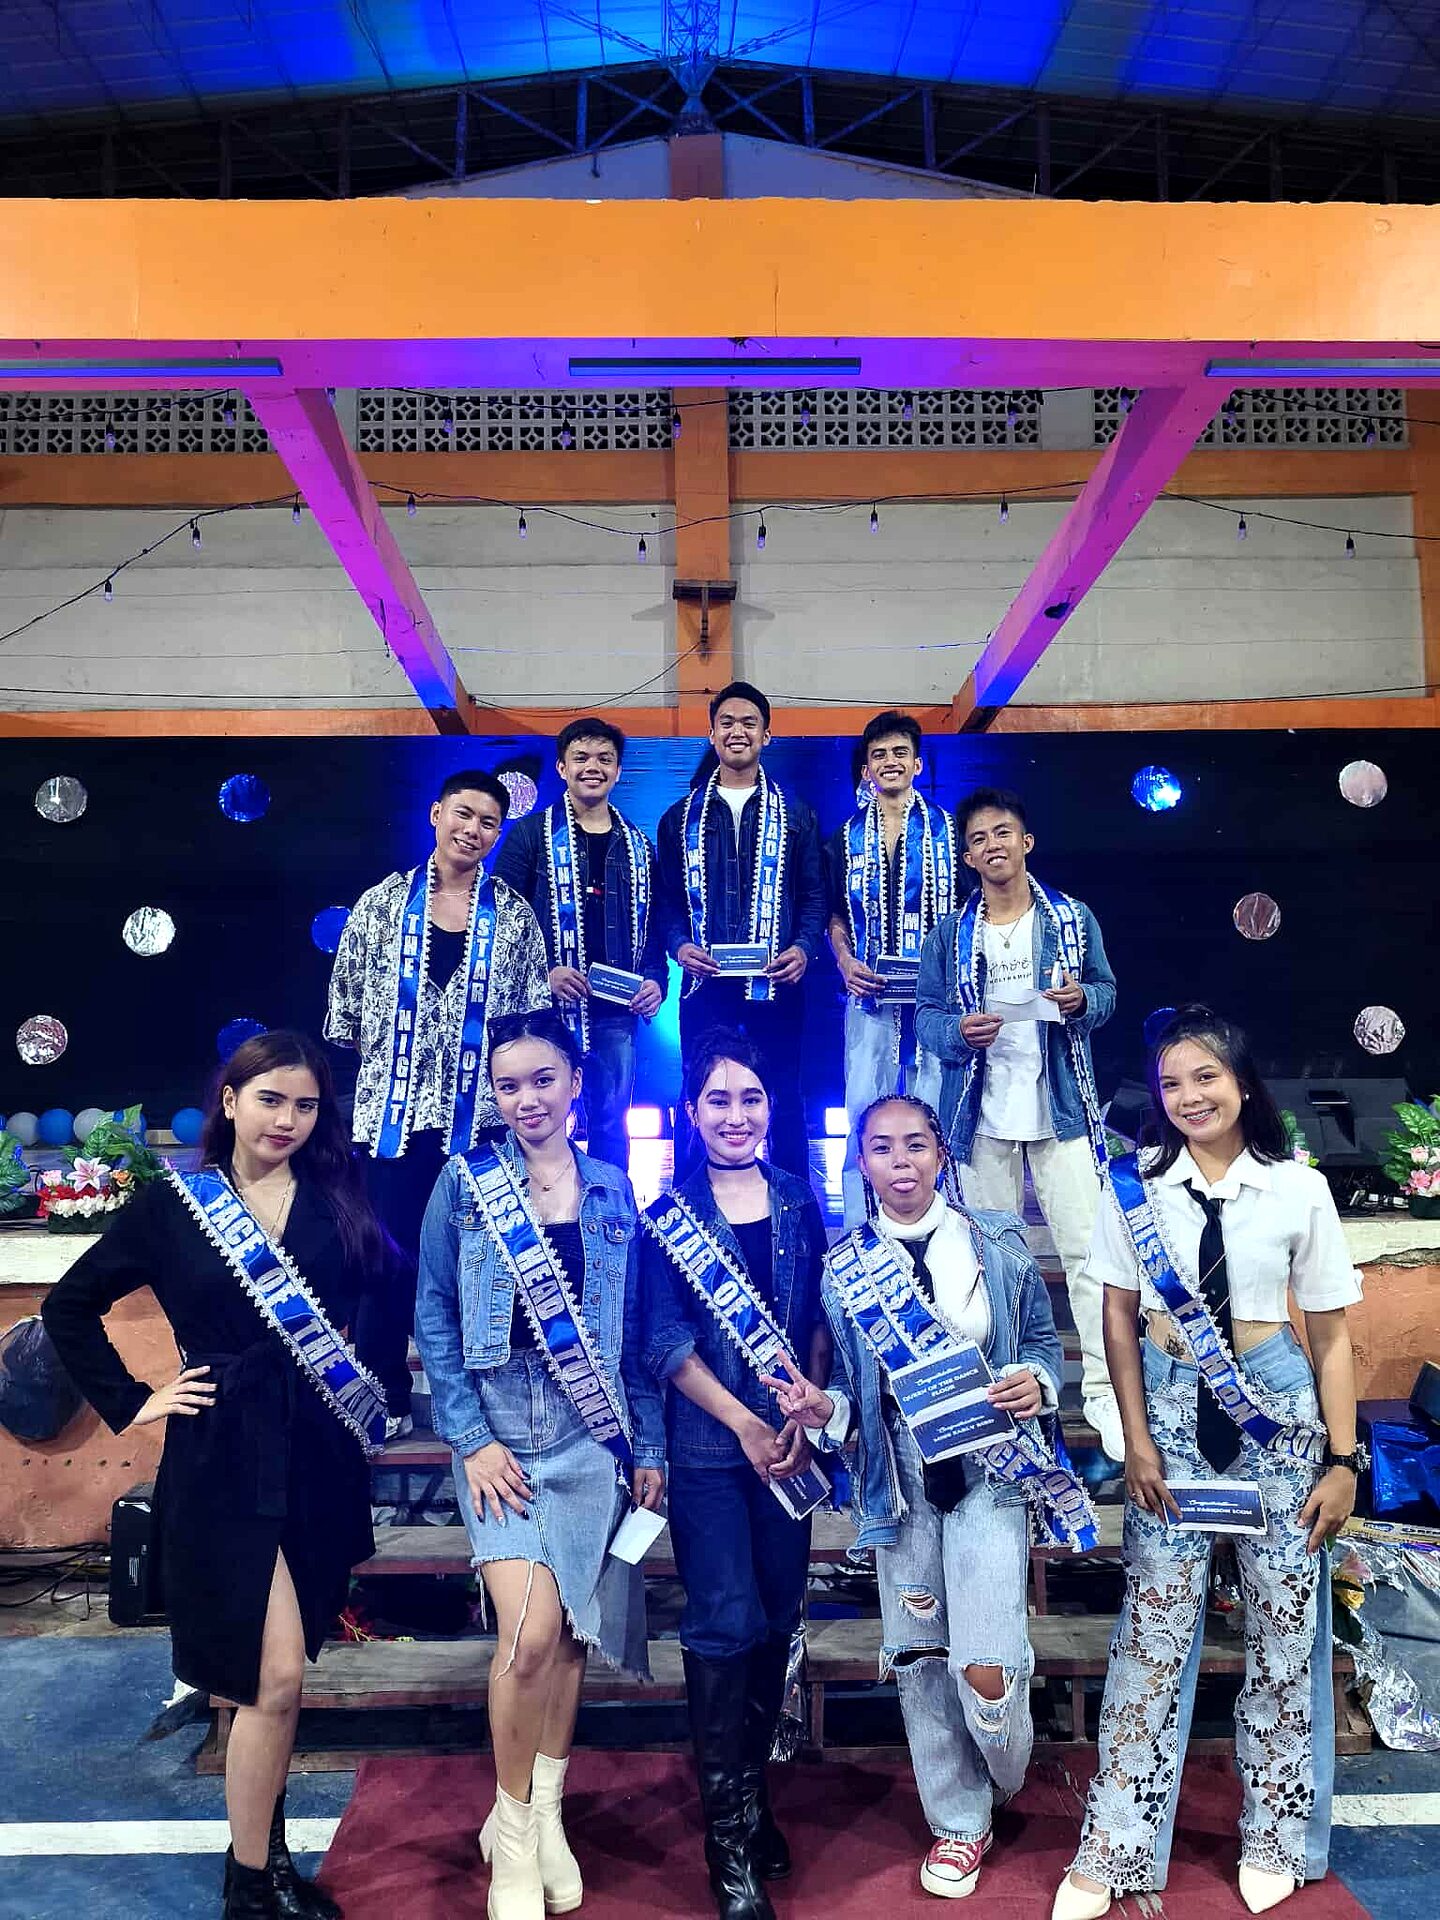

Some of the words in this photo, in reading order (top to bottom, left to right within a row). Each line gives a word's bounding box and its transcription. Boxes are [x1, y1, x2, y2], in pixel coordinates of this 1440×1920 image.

[767, 791, 779, 857] HEAD
[557, 846, 571, 904] THE
[936, 841, 950, 920] FASH
[402, 913, 421, 979] THE
[471, 918, 491, 1002] STAR
[904, 912, 919, 949] MR
[390, 1009, 412, 1125] NIGHT
[461, 1051, 478, 1093] OF
[203, 1189, 266, 1261] FACE
[255, 1267, 301, 1308] OF
[293, 1317, 346, 1377] THE
[476, 1167, 527, 1233] MISS
[514, 1243, 565, 1321] HEAD
[554, 1343, 621, 1441] TURNER
[656, 1206, 717, 1276] STAR
[712, 1280, 752, 1318] OF
[745, 1319, 785, 1375] THE
[829, 1242, 880, 1312] UEEN
[868, 1318, 899, 1352] OF
[861, 1243, 913, 1311] MISS
[1125, 1203, 1169, 1277] MISS
[1174, 1297, 1261, 1425] FASHION
